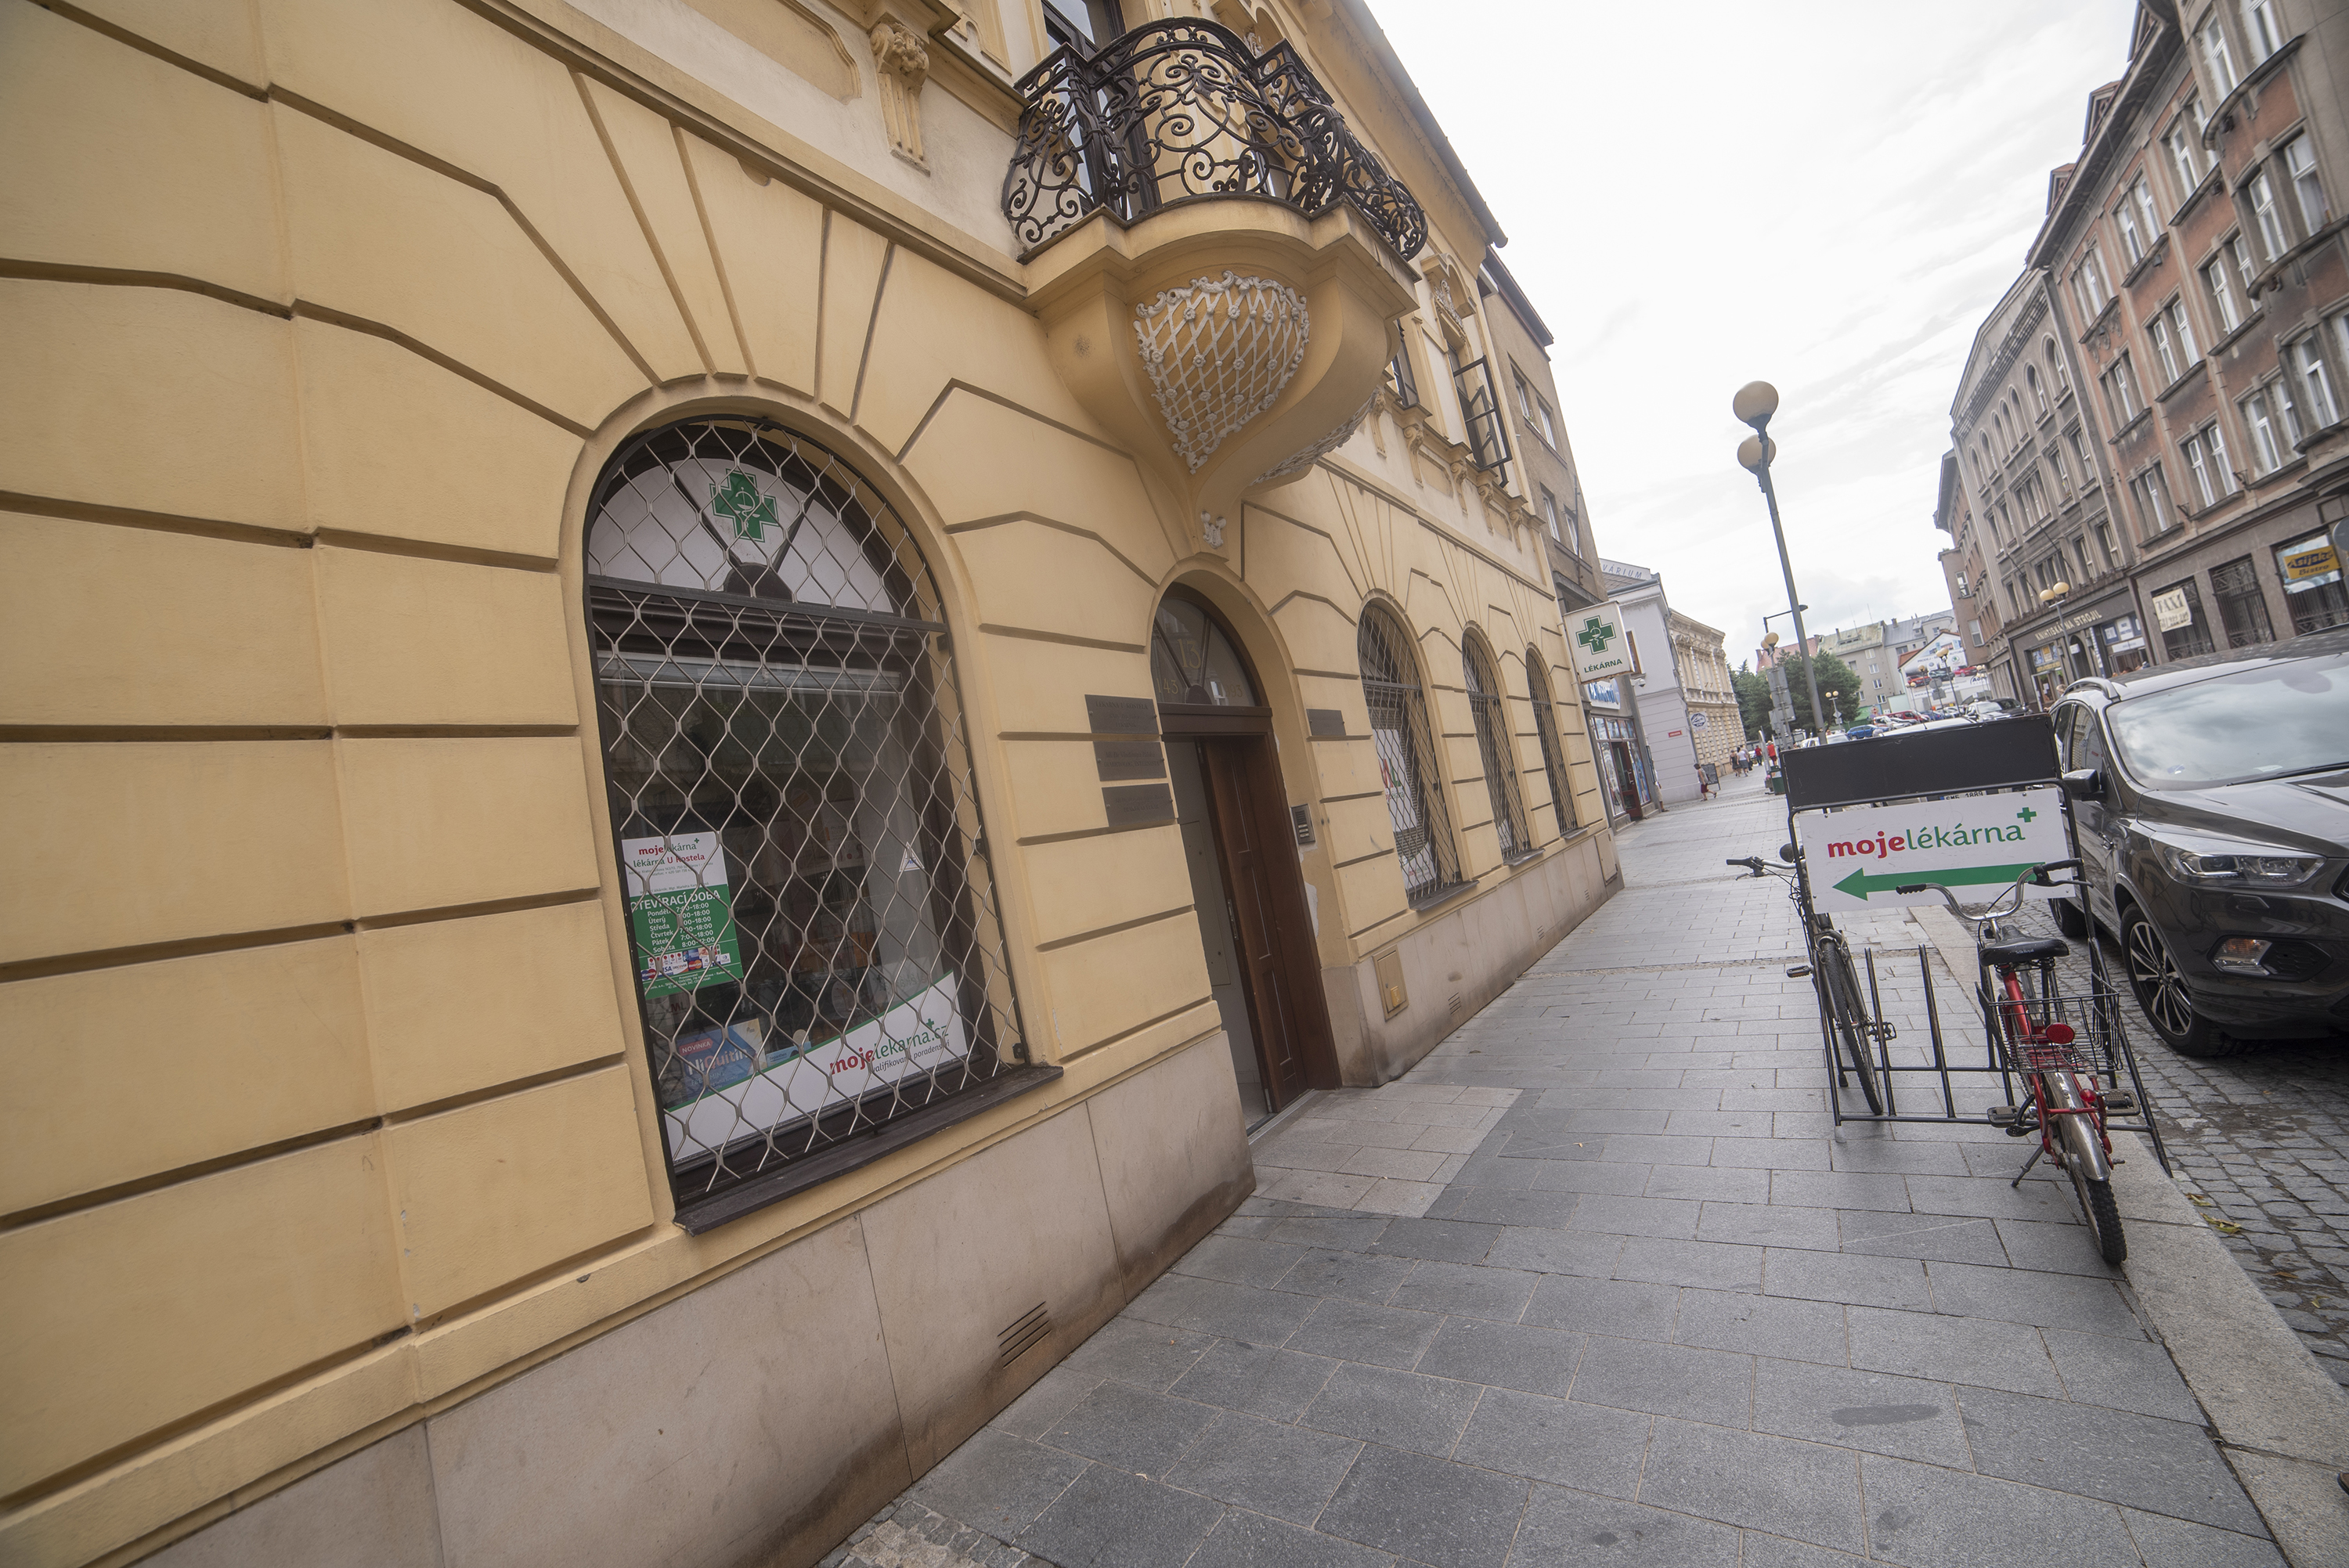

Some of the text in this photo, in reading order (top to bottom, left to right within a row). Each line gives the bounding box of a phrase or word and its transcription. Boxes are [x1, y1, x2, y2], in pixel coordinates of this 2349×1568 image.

[2299, 564, 2329, 575] Bistro
[2035, 609, 2103, 641] KNIHTISKÁNA STROJIL
[1177, 638, 1202, 669] 13
[1584, 658, 1622, 673] LÉKÁRNA
[1156, 678, 1178, 694] 143
[1827, 823, 2026, 858] mojelékárna
[691, 890, 720, 903] DOBA
[651, 930, 673, 939] Čtvrtek
[682, 1041, 711, 1054] NOVINKA
